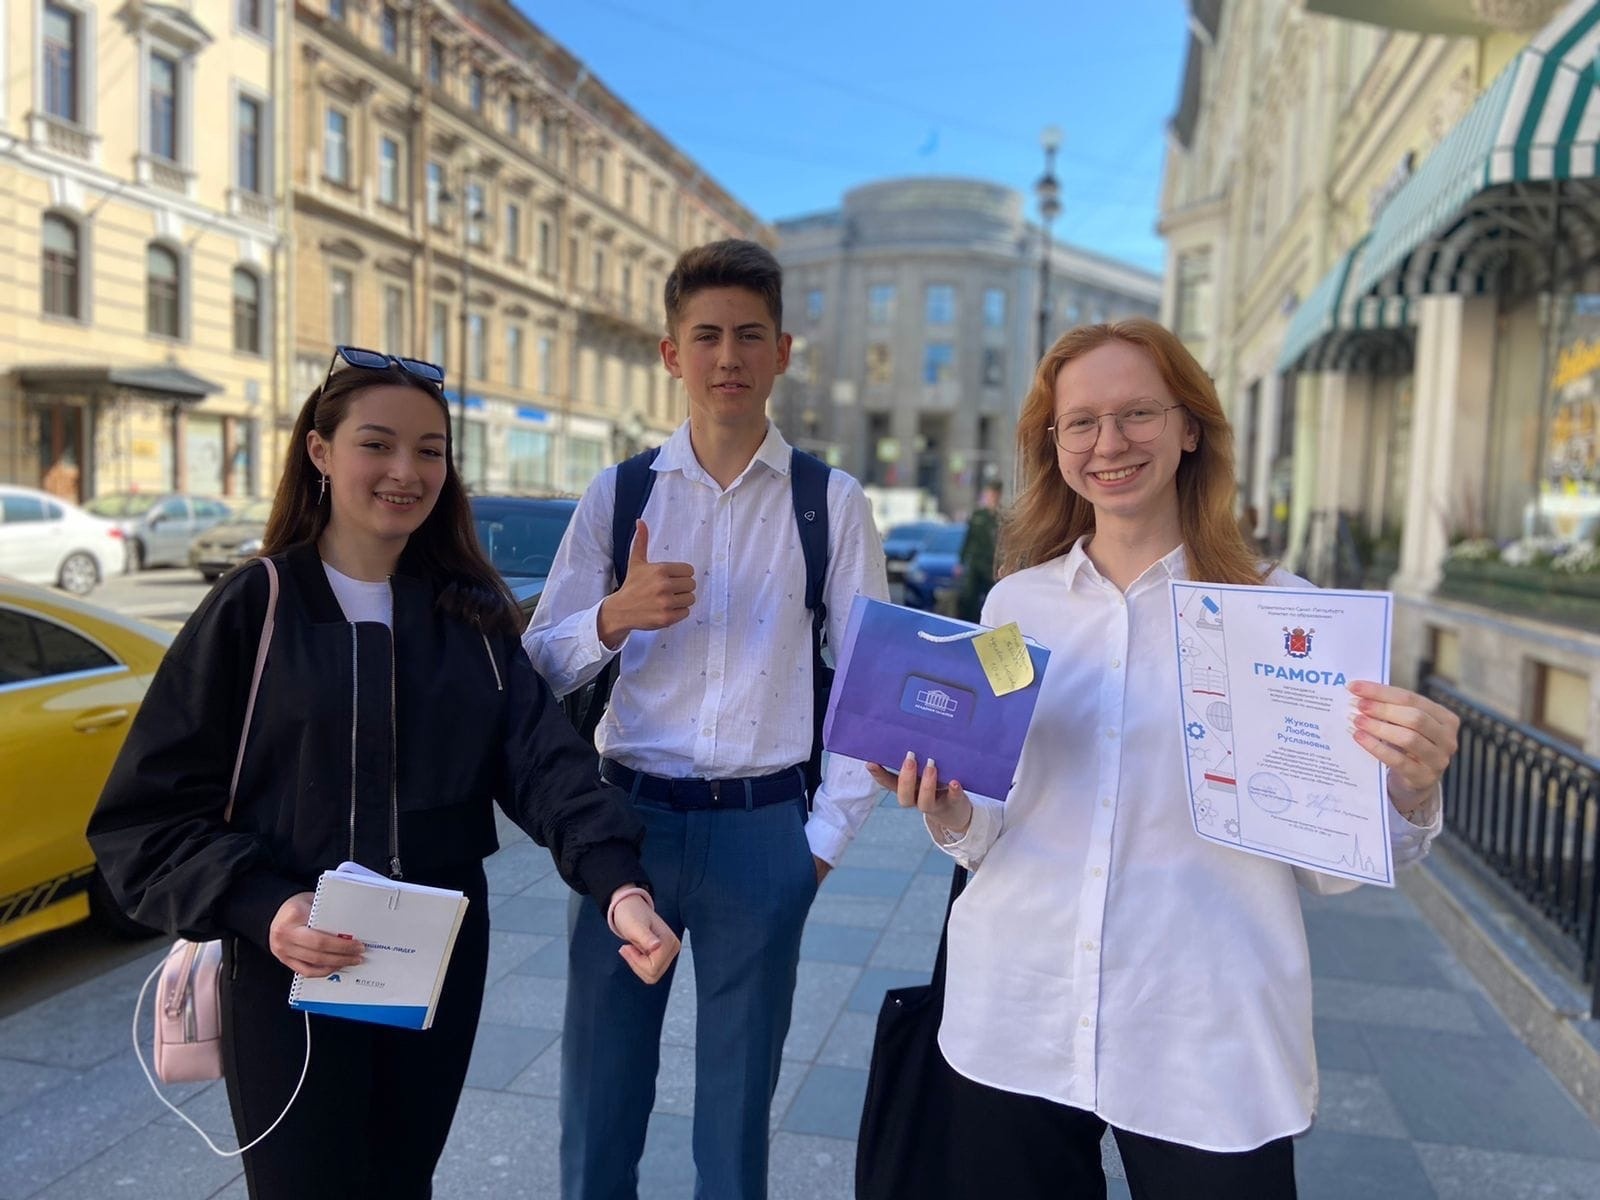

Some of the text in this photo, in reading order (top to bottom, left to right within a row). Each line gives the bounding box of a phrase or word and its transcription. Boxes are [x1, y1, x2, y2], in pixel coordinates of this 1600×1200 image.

[1254, 662, 1346, 686] ГРАМОТА
[1284, 716, 1320, 730] Жукова
[1285, 725, 1321, 739] Любовь
[1277, 733, 1331, 751] Руслановна
